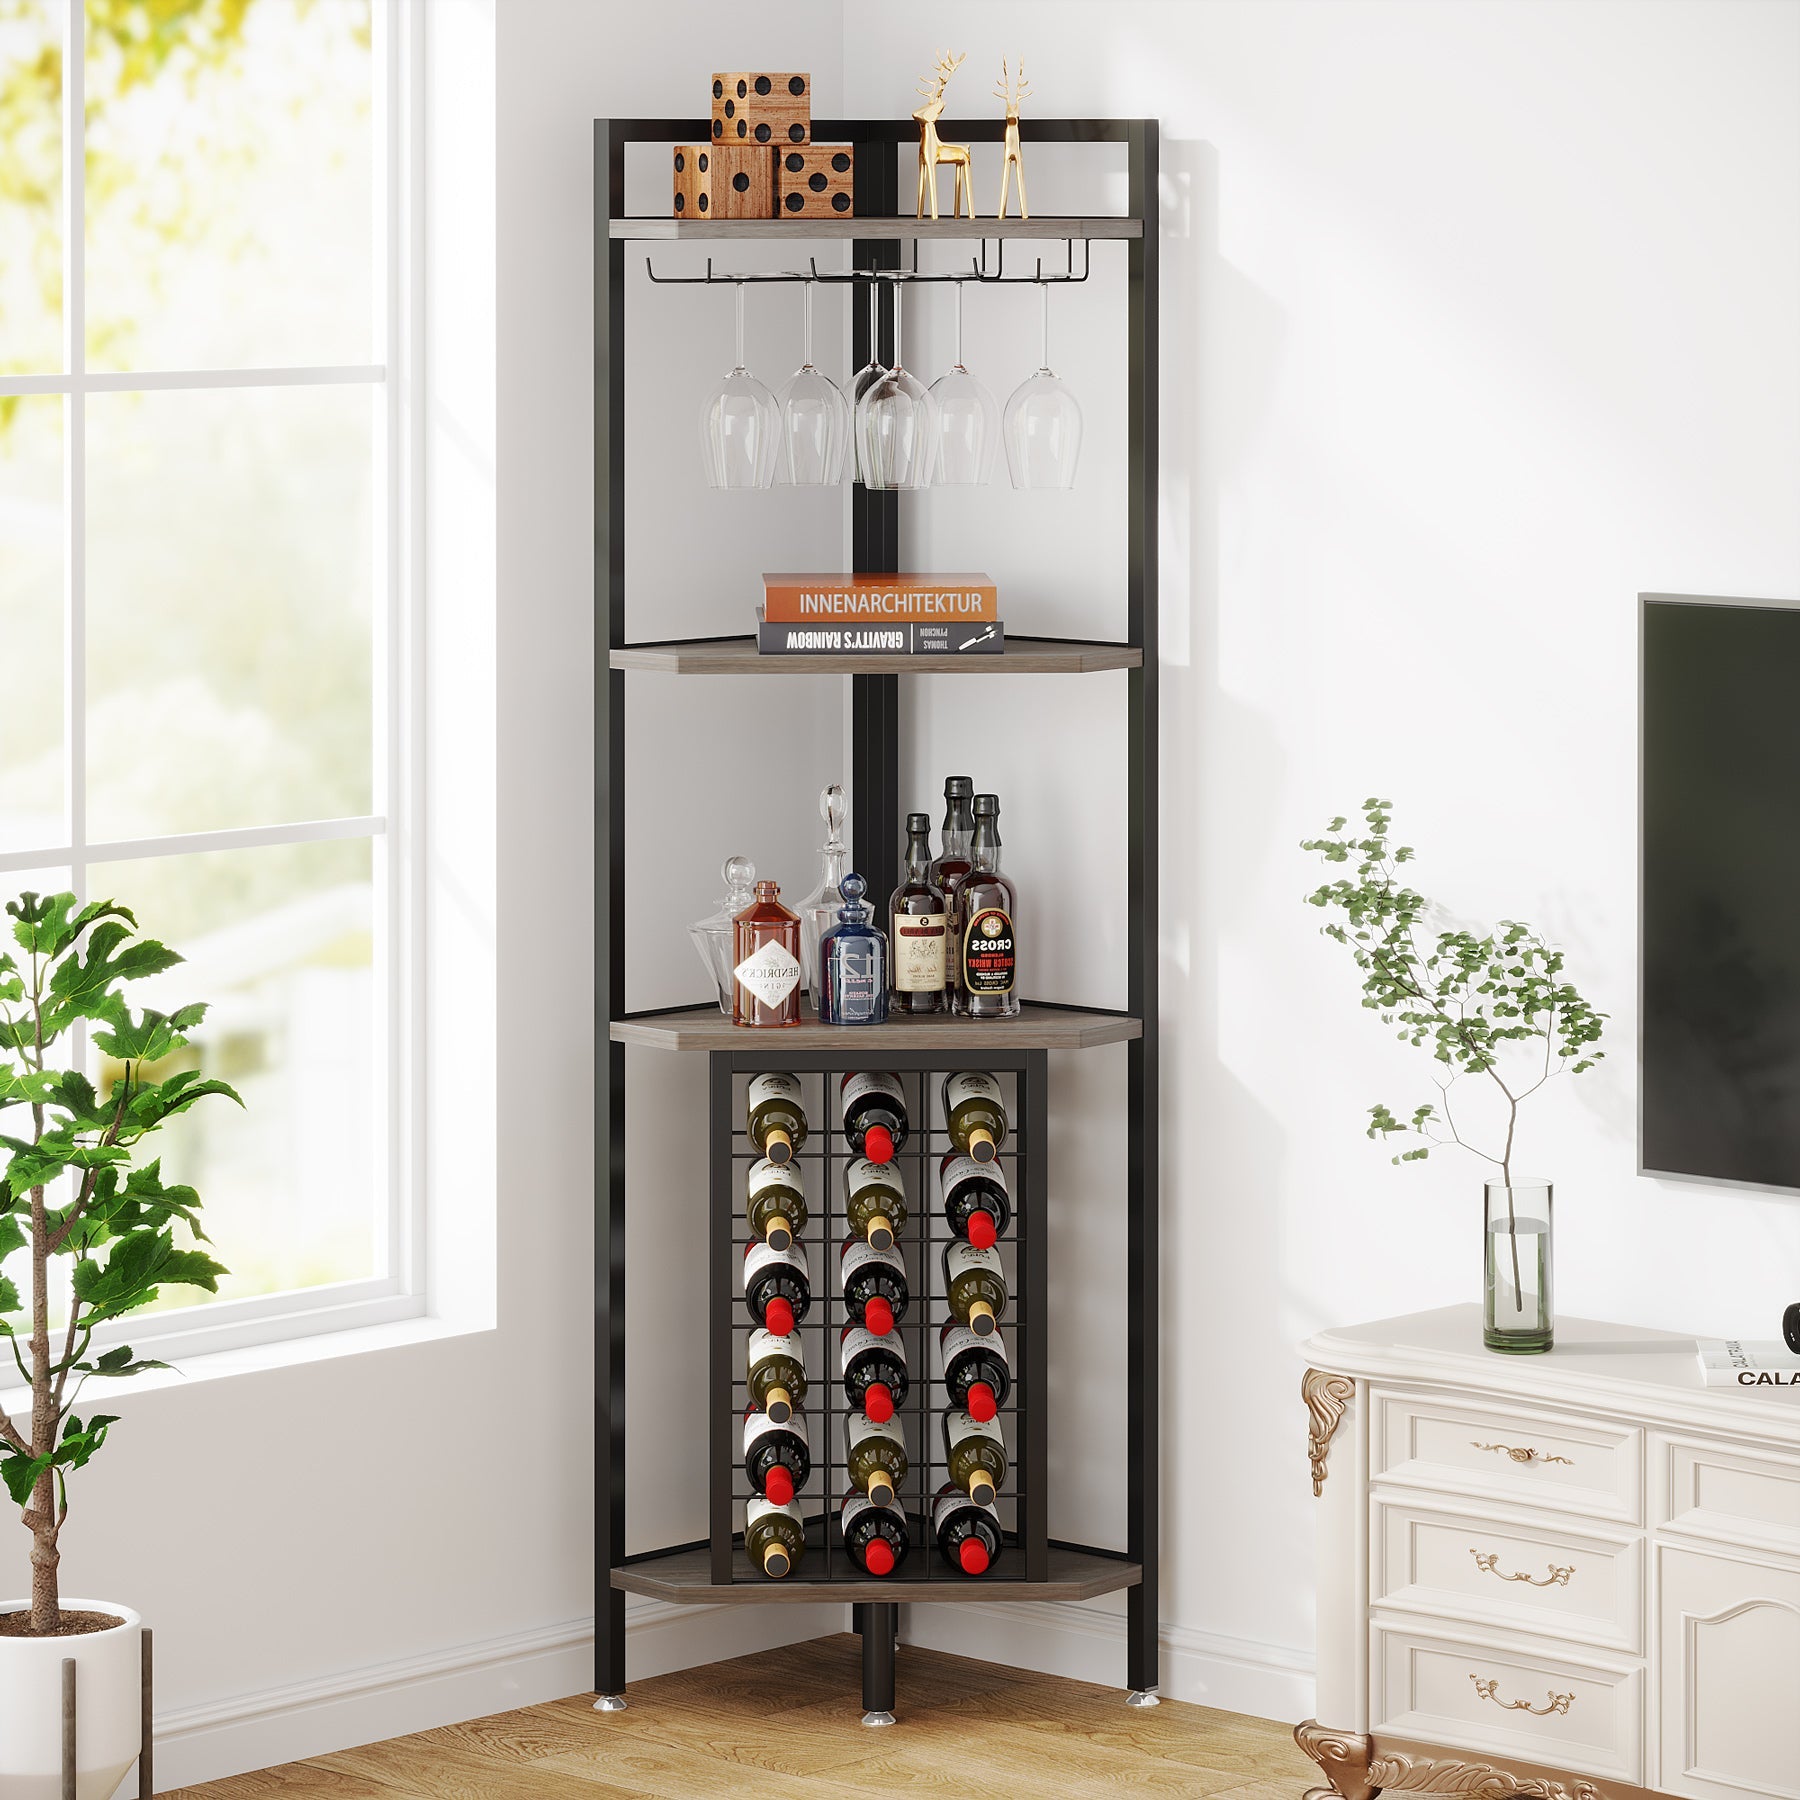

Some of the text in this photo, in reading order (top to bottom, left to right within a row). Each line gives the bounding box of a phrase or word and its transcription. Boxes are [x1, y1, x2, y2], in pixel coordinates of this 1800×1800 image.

[800, 593, 982, 613] INNENARCHITEKTUR
[919, 627, 948, 637] PYNCHON
[786, 631, 904, 649] GRAVITY'S RAINBOW
[923, 640, 948, 649] THOMAS
